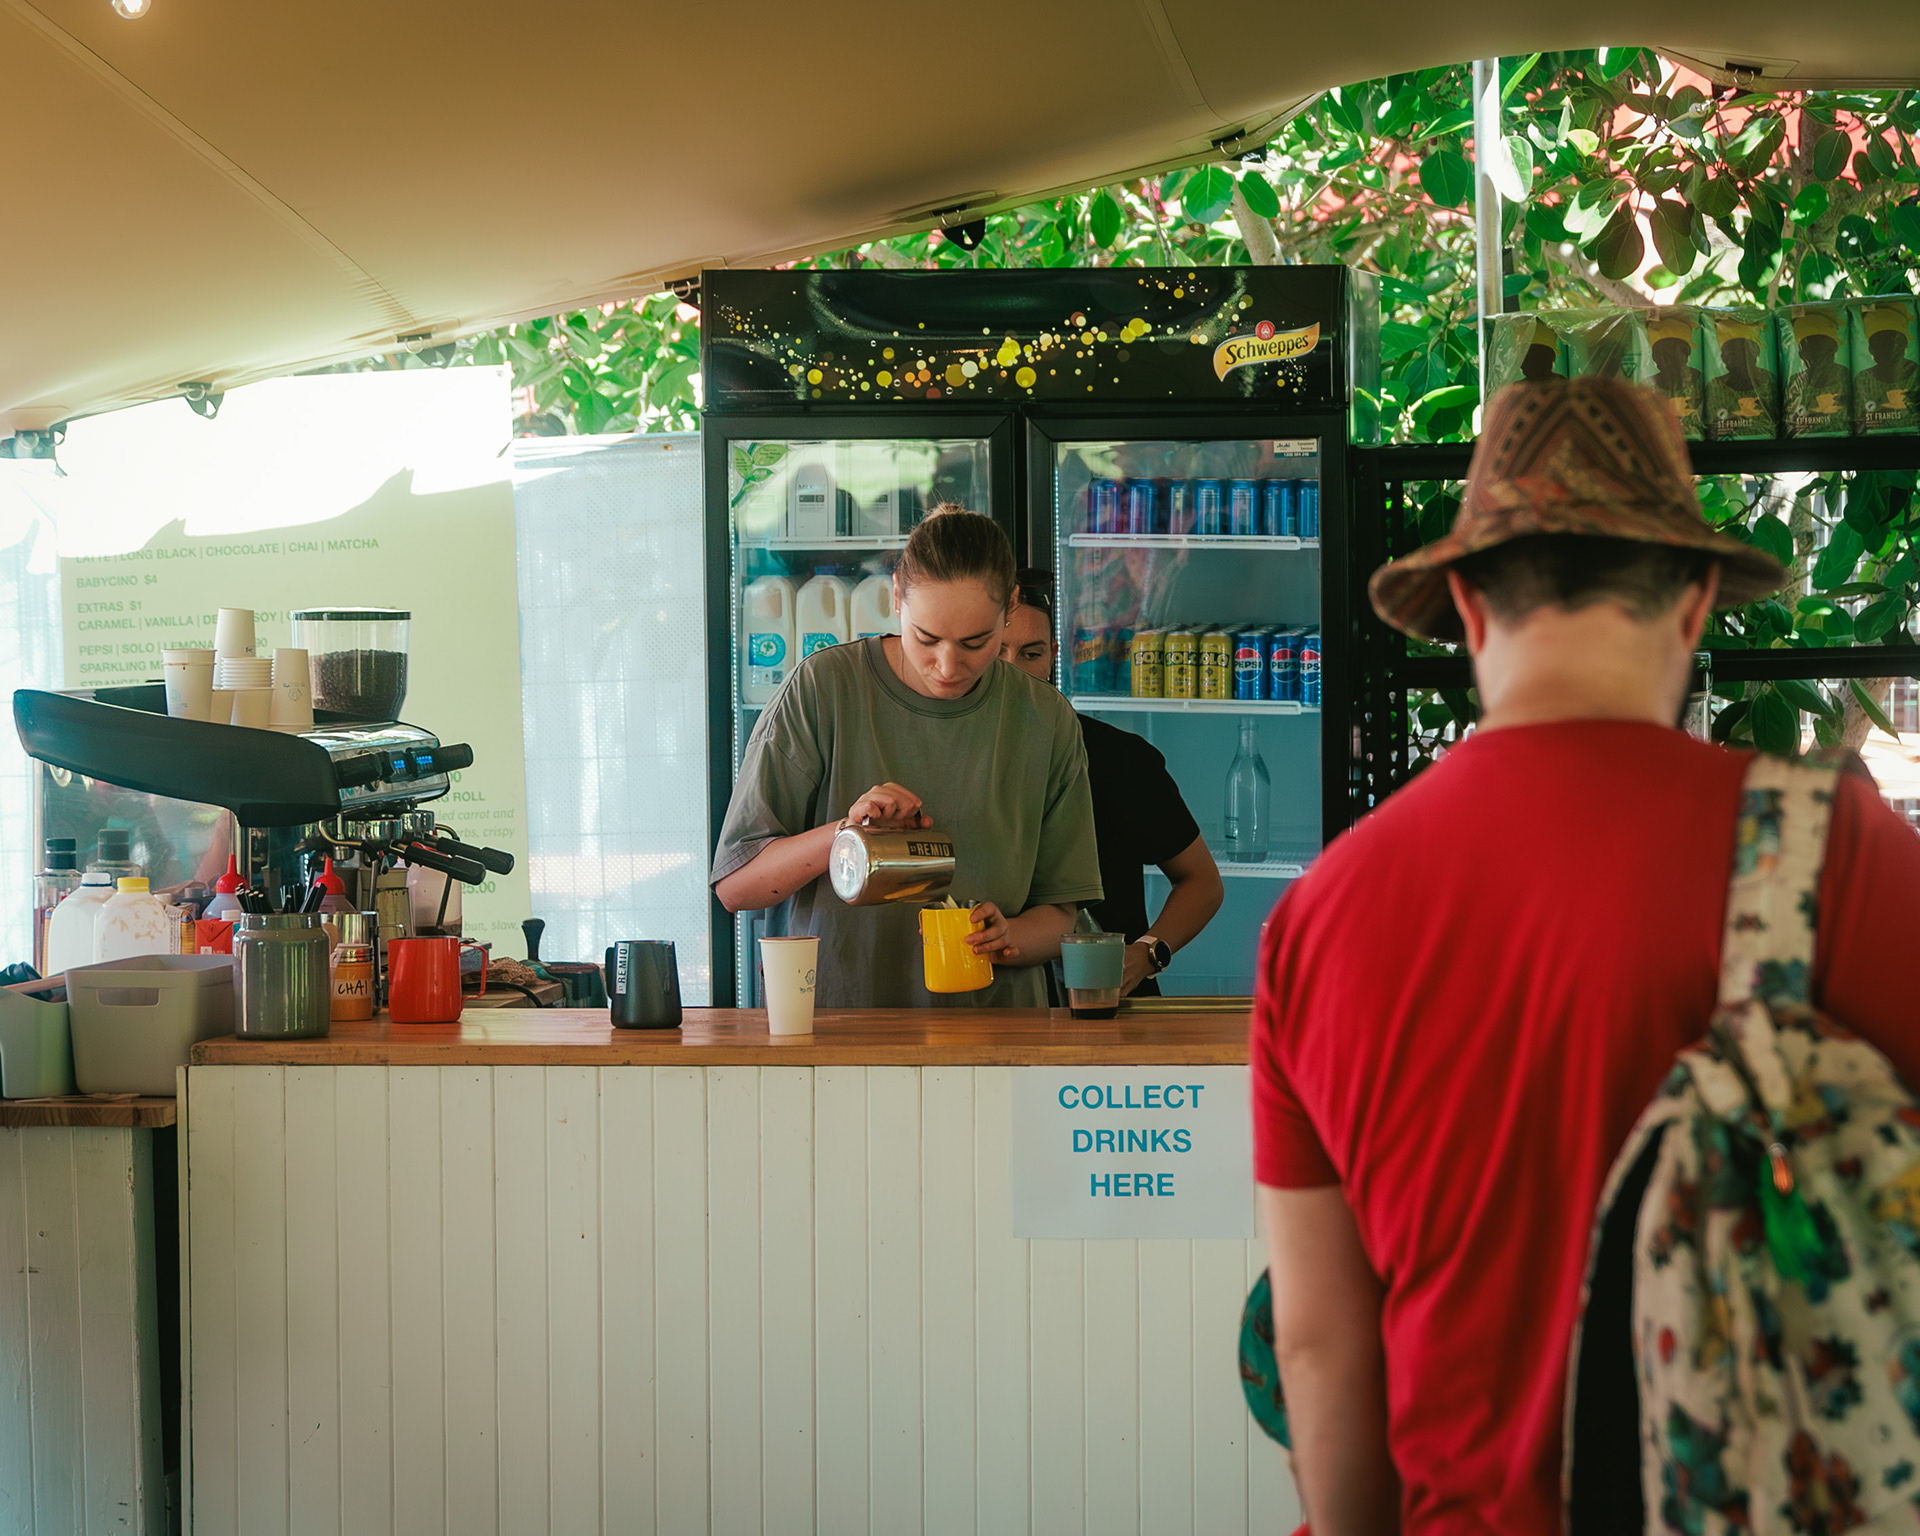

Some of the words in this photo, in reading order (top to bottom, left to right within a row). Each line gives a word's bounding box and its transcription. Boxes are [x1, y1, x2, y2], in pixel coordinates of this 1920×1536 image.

[1225, 335, 1309, 365] Schweppes
[120, 548, 153, 561] LONG
[156, 547, 197, 560] BLACK
[206, 543, 279, 557] CHOCOLATE
[288, 541, 318, 553] CHAI
[328, 538, 380, 551] MATCHA
[76, 575, 138, 588] BABYCINO
[144, 574, 158, 585] $4
[77, 601, 124, 613] EXTRAS
[130, 600, 142, 611] $1
[78, 618, 136, 631] CARAMEL
[145, 615, 194, 627] VANILLA
[79, 644, 113, 656] PEPSI
[122, 643, 154, 654] SOLO
[164, 640, 215, 651] LEMONA
[1135, 651, 1161, 666] SOL
[1200, 653, 1229, 667] OLO
[1235, 660, 1262, 669] PEPSI
[79, 661, 147, 674] SPARKLING
[453, 791, 486, 802] ROLL
[457, 810, 490, 820] carrot
[493, 808, 515, 819] and
[458, 828, 479, 838] rbs,
[483, 826, 515, 838] crispy
[917, 843, 950, 857] REMIO
[461, 881, 496, 894] 25.00
[617, 948, 628, 984] REMIO
[338, 979, 368, 996] CHAI
[1058, 1084, 1205, 1109] COLLECT
[1072, 1129, 1192, 1153] DRINKS
[1090, 1173, 1175, 1197] HERE
